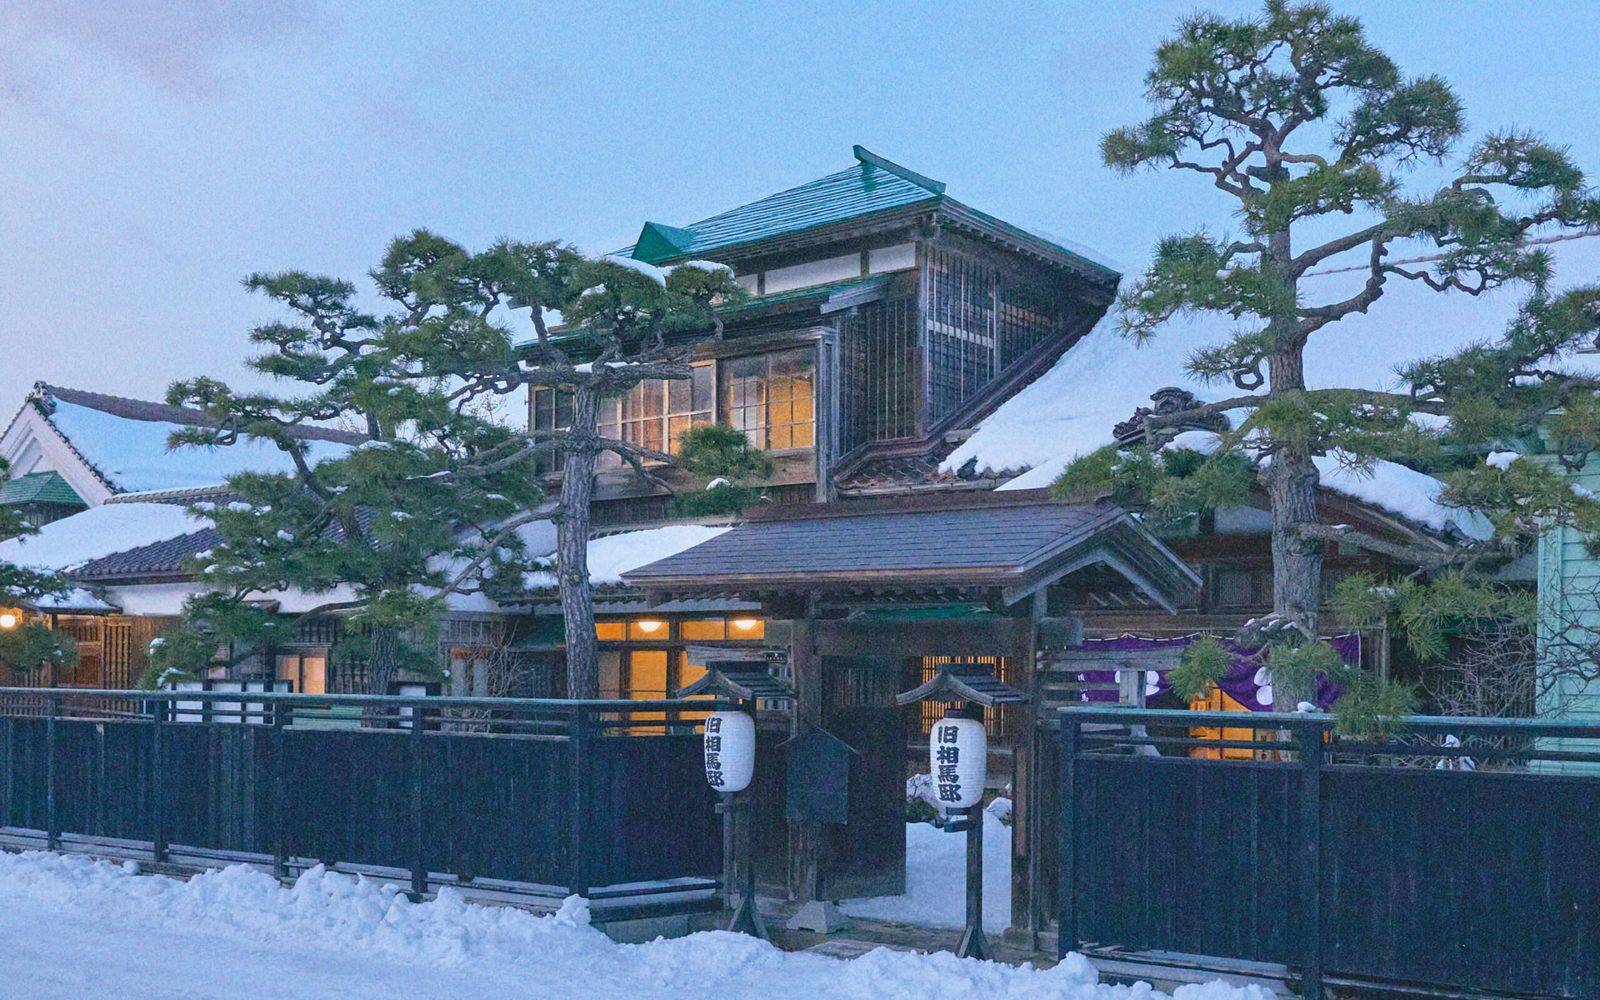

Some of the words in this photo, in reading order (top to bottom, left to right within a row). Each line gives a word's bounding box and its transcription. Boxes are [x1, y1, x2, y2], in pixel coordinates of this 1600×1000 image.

[706, 717, 725, 788] 旧相馬邸
[937, 725, 962, 803] 旧相馬邸
